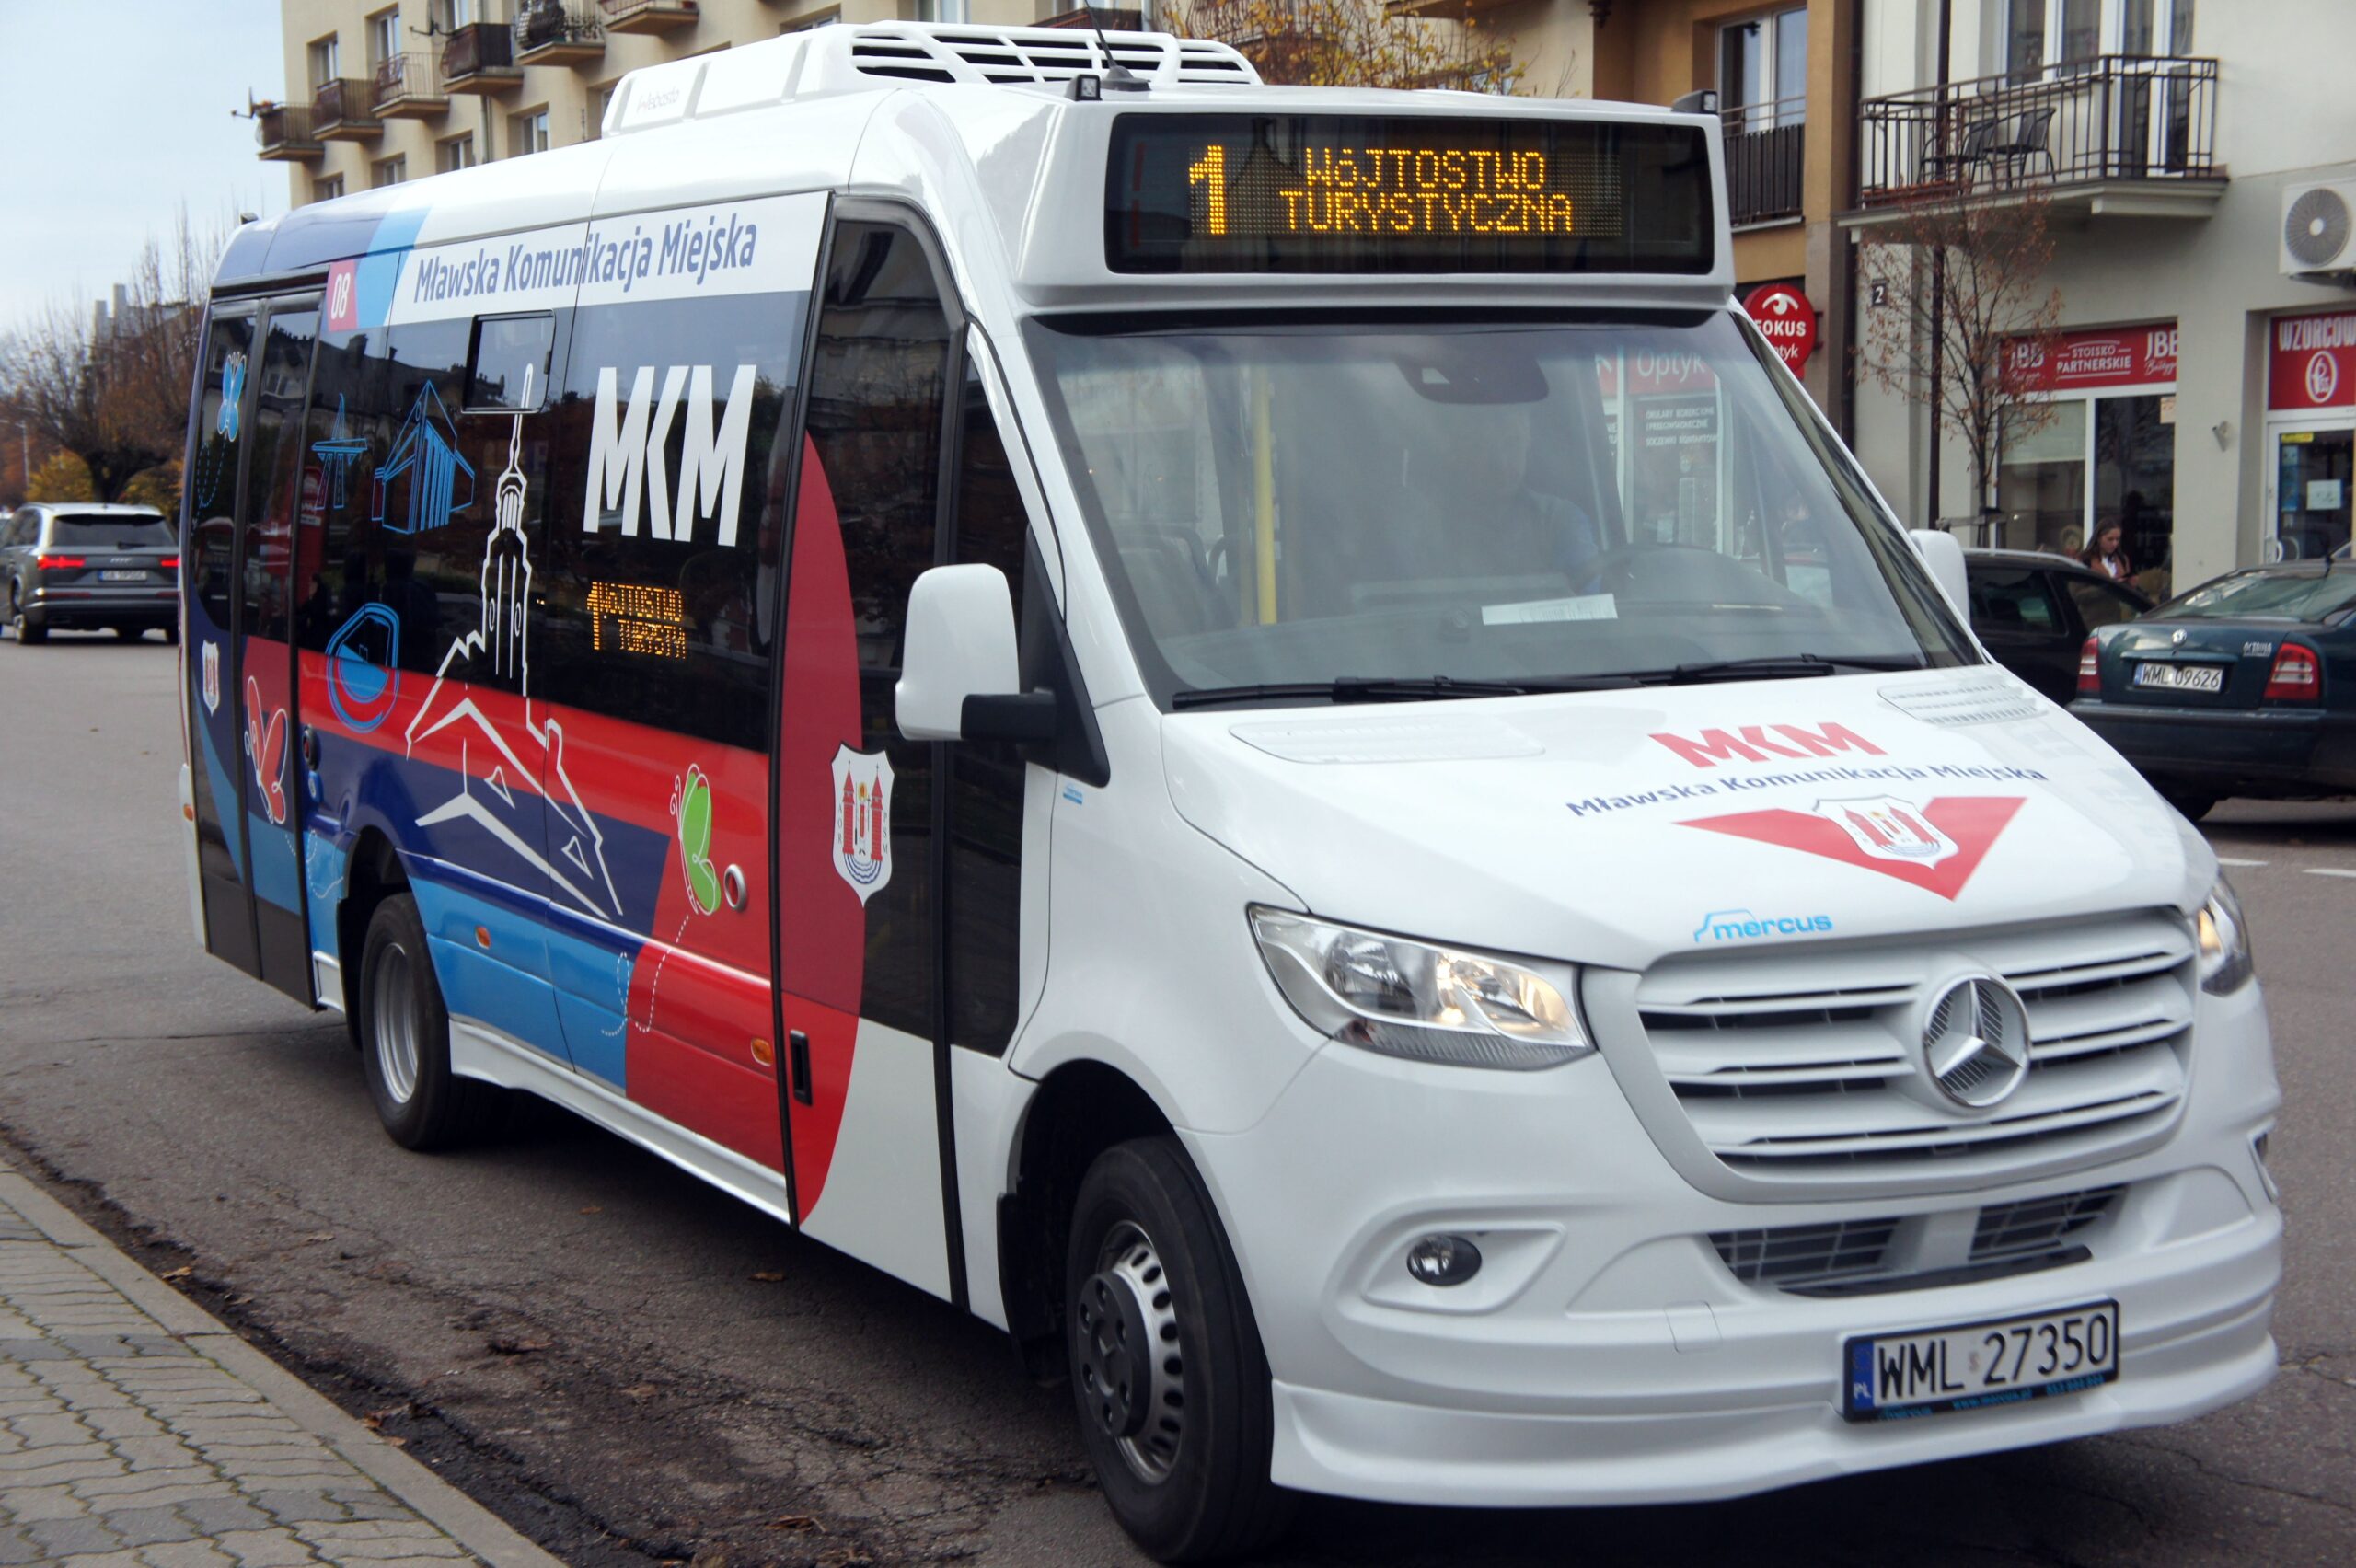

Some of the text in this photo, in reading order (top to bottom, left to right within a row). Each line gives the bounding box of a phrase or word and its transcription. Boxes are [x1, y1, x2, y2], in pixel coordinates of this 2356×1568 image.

[1189, 144, 1226, 235] 1
[1279, 190, 1574, 234] TURYSTYCZNA
[413, 213, 757, 304] Mławska Komunikacja Miejska
[330, 271, 352, 320] 08
[1875, 285, 1885, 304] 2
[1636, 346, 1706, 386] Optyk
[1773, 343, 1799, 362] tyk
[2056, 355, 2132, 374] PARTNERSKIE
[2072, 344, 2117, 358] STOISKO
[583, 364, 757, 548] MKM
[2142, 663, 2221, 689] WML 09626
[1647, 721, 1890, 768] MKM
[1565, 764, 2050, 817] Mławska Komunikacja Miejska
[1712, 914, 1835, 940] mercus
[1877, 1313, 2109, 1400] WML 27350
